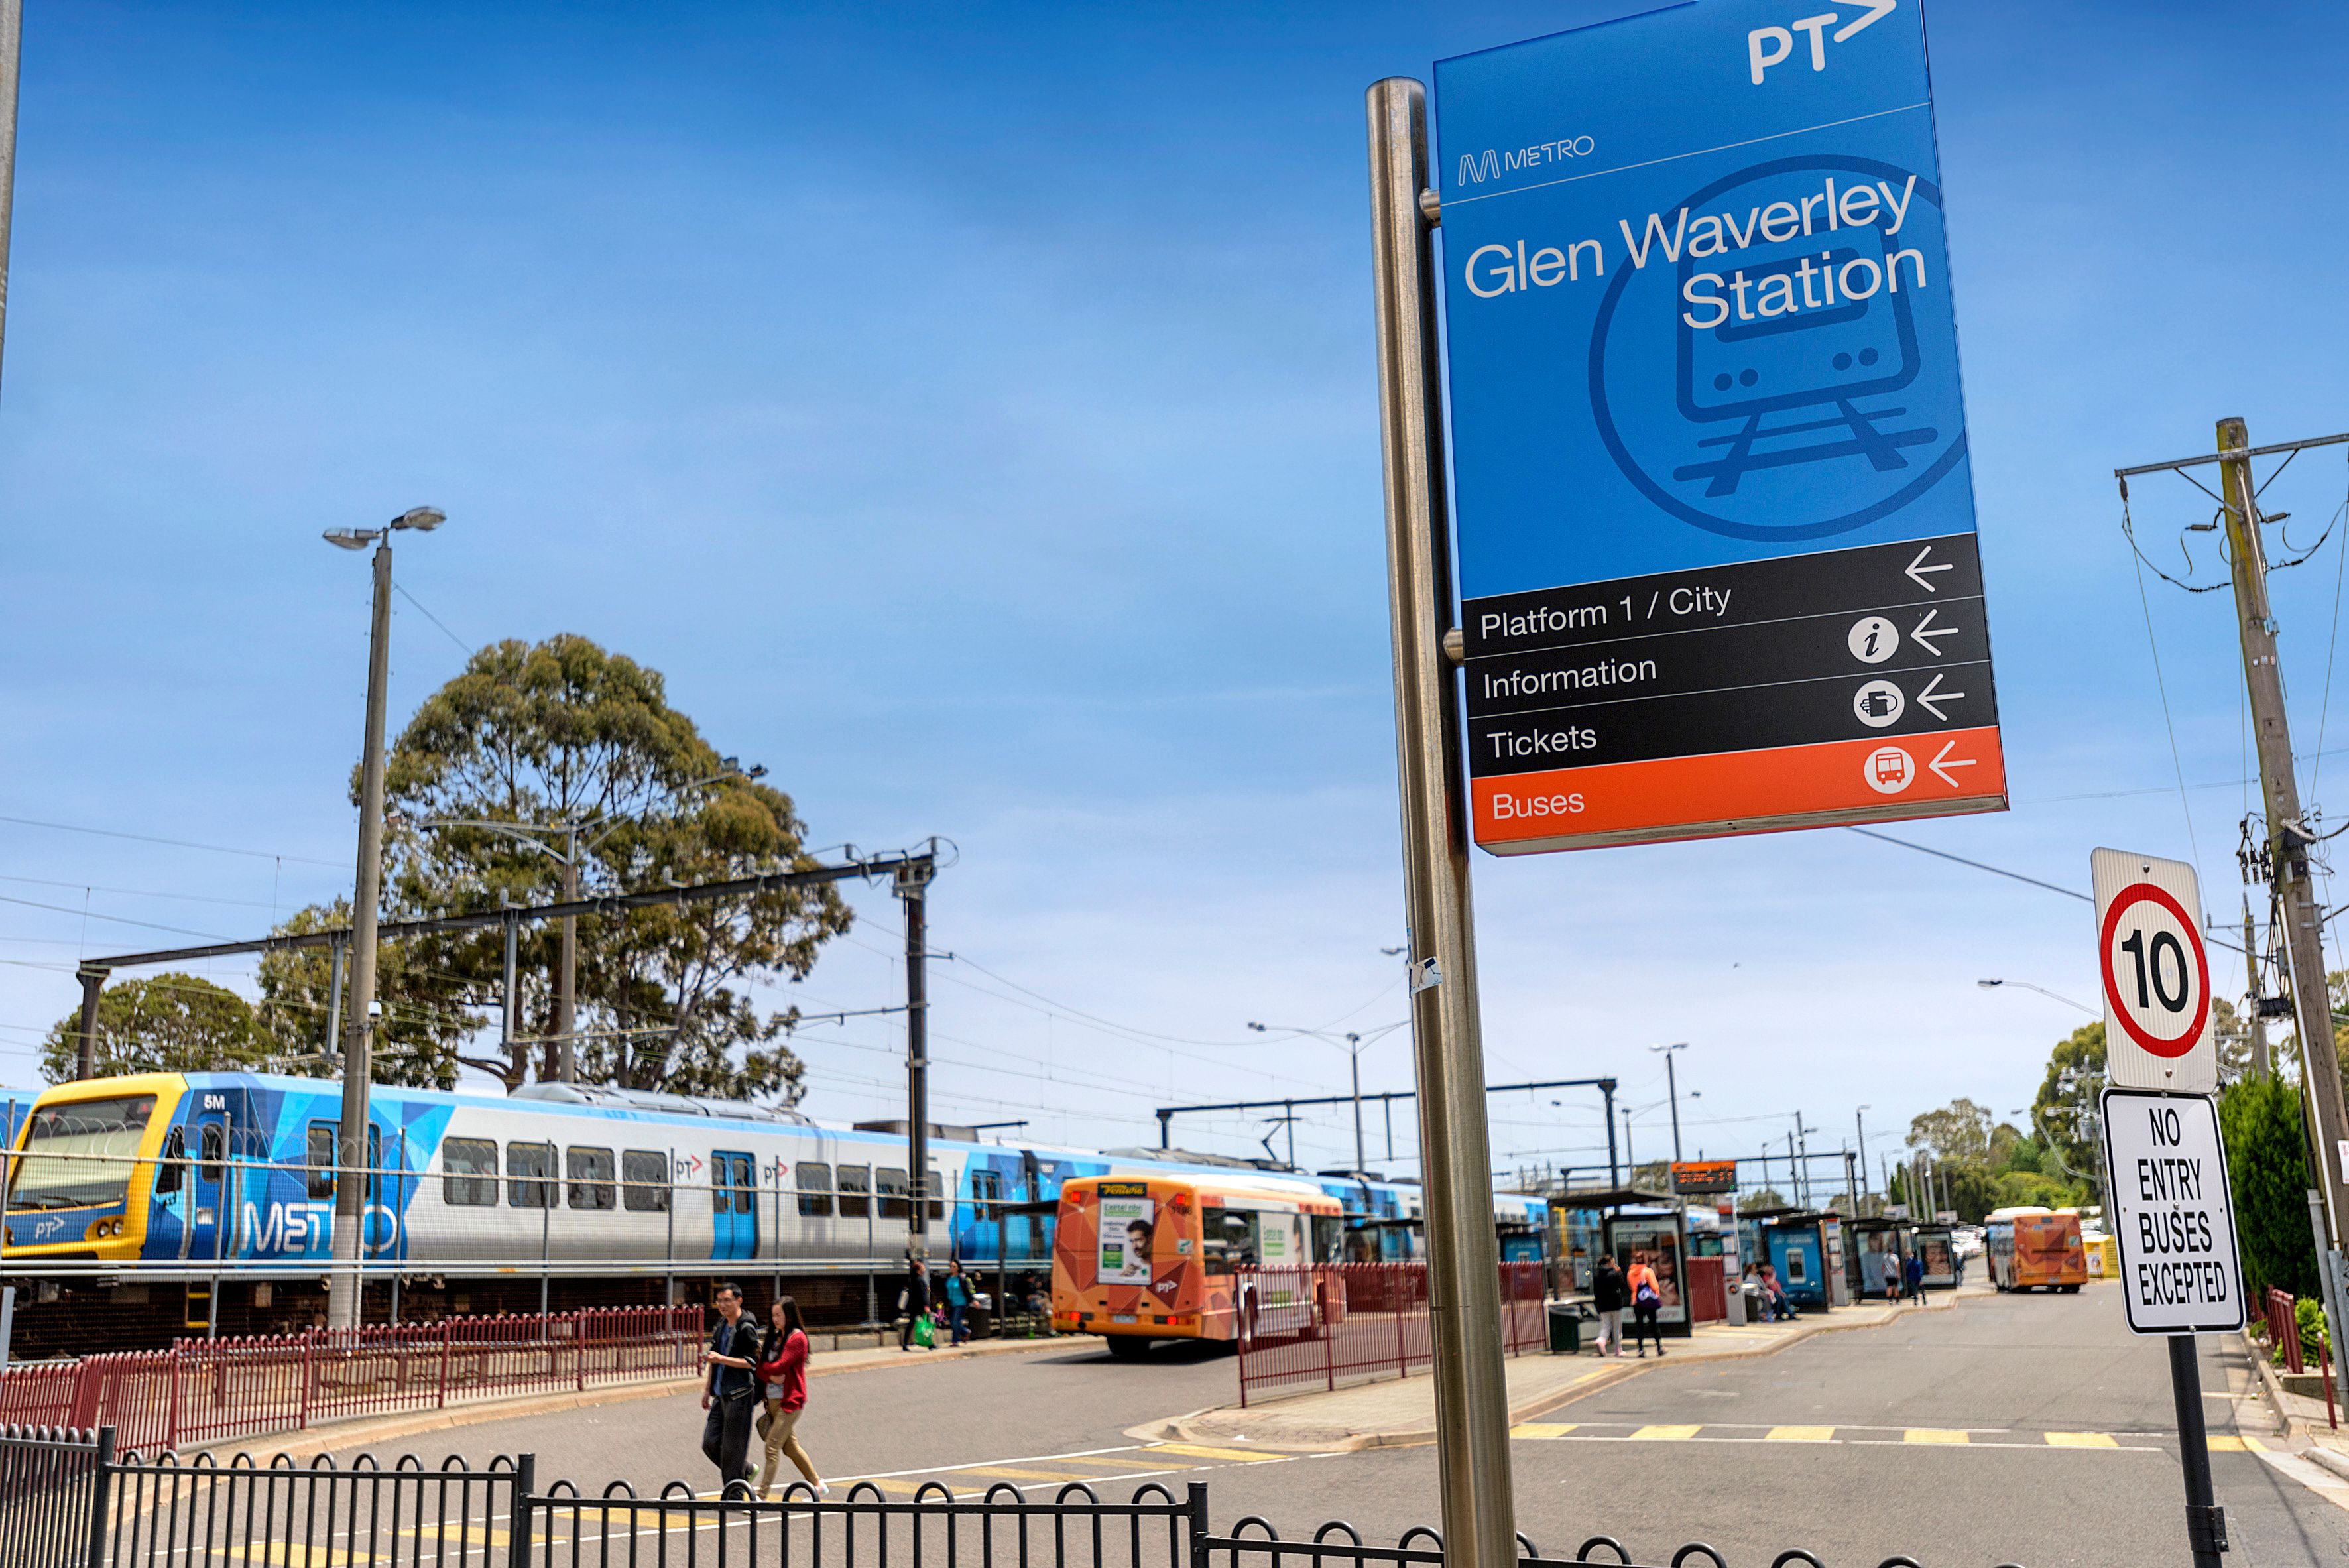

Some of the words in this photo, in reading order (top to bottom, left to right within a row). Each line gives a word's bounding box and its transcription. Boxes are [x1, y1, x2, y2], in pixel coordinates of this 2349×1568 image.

[1504, 135, 1595, 172] METRO
[1465, 239, 1604, 298] Glen
[1618, 175, 1917, 269] Waverley
[1682, 249, 1927, 329] Station
[1480, 605, 1608, 640] Platform
[1620, 595, 1632, 622] 1
[1669, 585, 1732, 617] City
[1484, 660, 1657, 699] Information
[1486, 725, 1598, 758] Tickets
[1492, 793, 1585, 819] Buses
[2121, 928, 2189, 1013] 10
[2149, 1107, 2181, 1146] NO
[1101, 1184, 1145, 1195] Ventura
[2137, 1158, 2201, 1201] ENTRY
[241, 1201, 398, 1252] METO
[2138, 1211, 2213, 1254] BUSES
[2138, 1261, 2226, 1305] EXCEPTED
